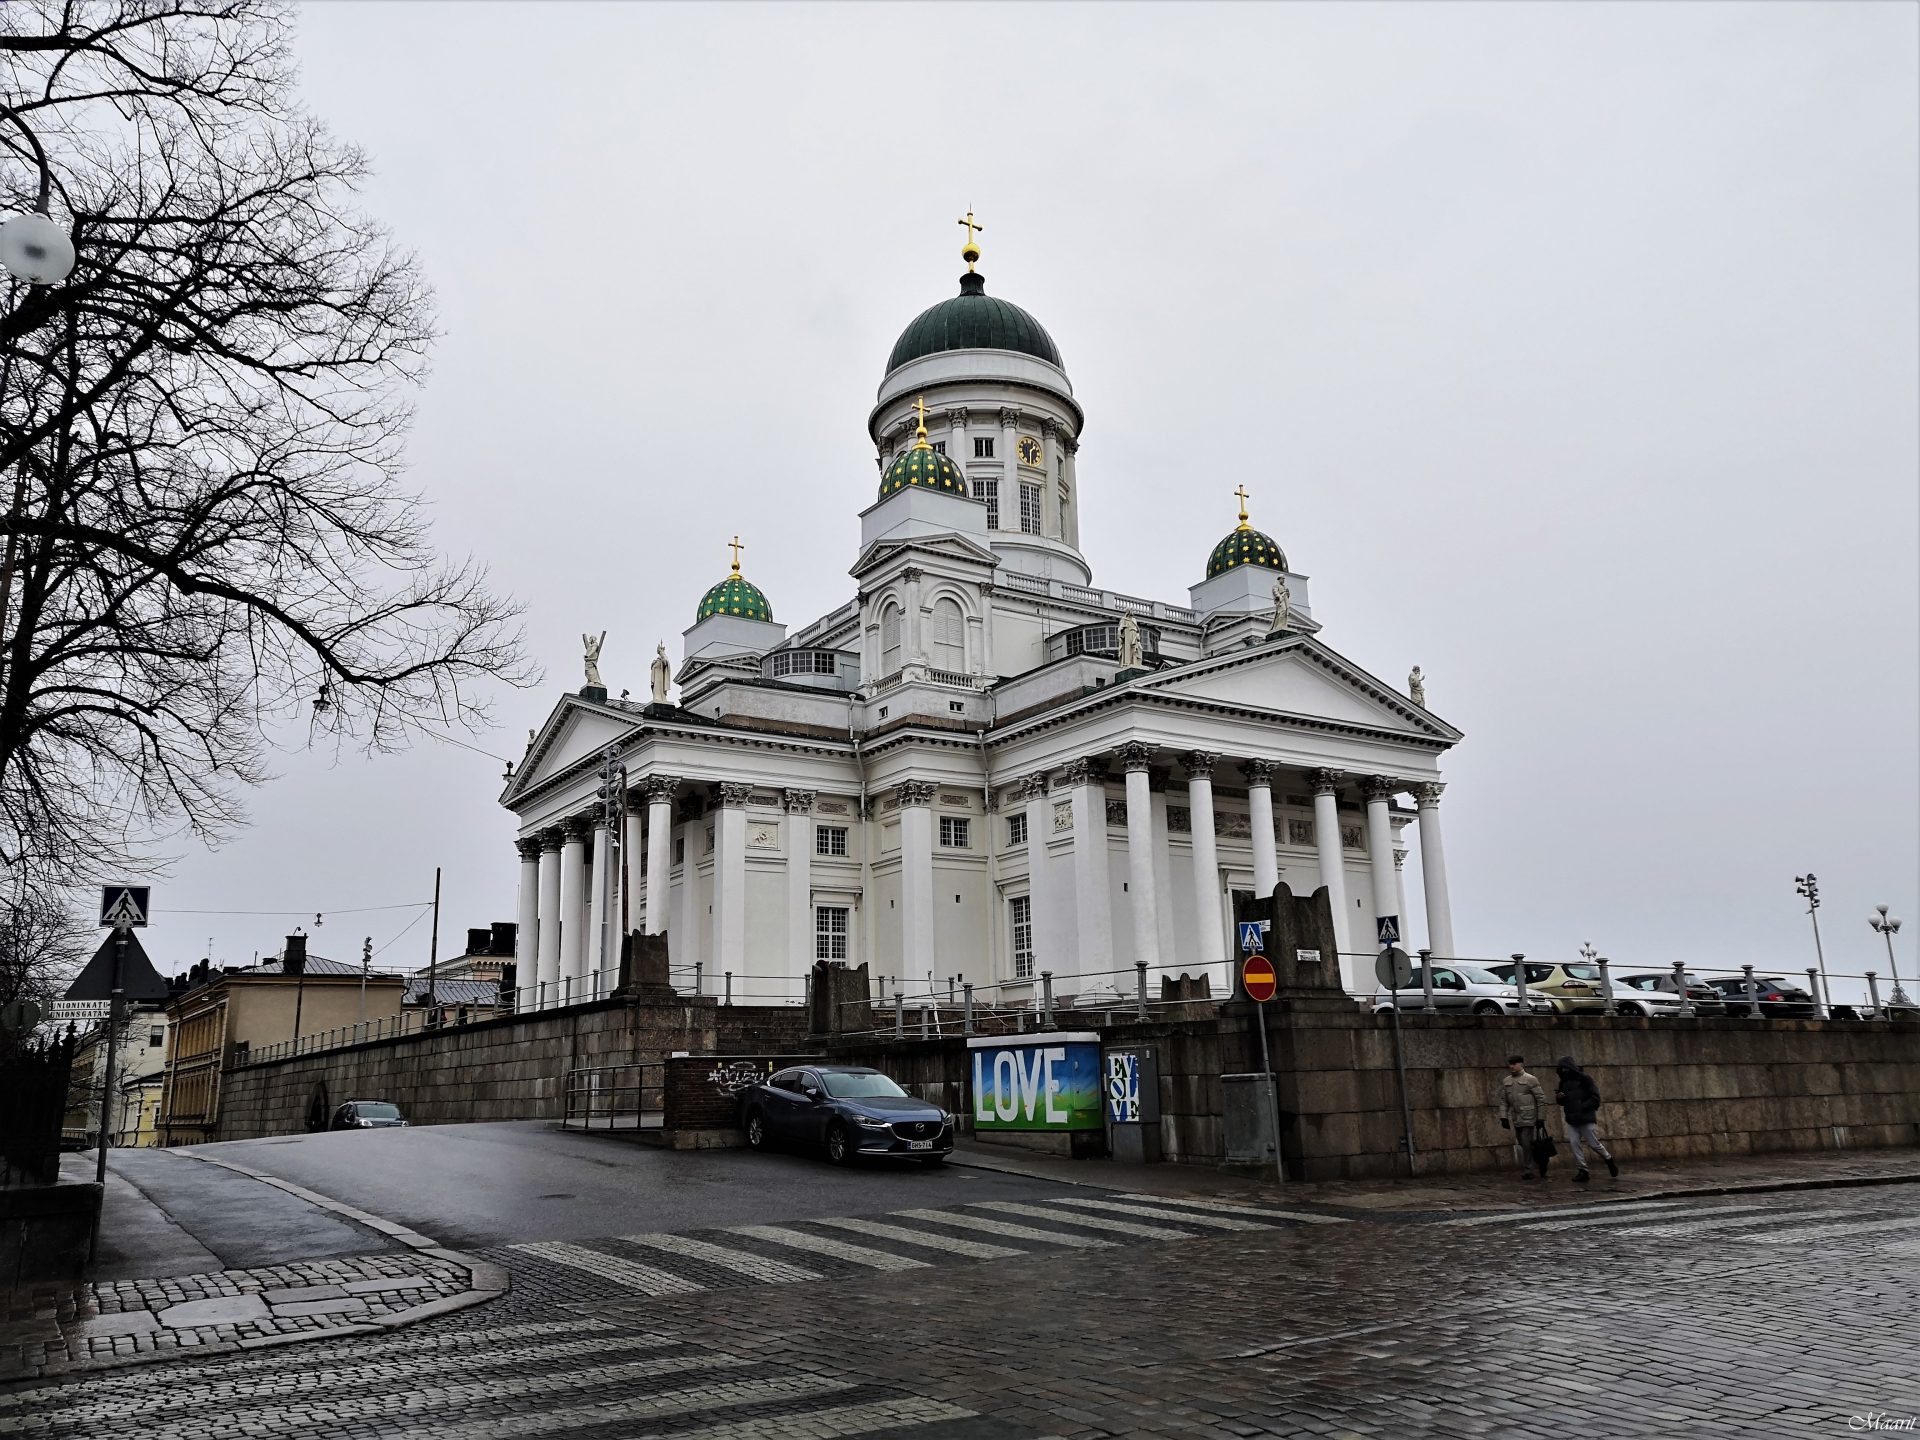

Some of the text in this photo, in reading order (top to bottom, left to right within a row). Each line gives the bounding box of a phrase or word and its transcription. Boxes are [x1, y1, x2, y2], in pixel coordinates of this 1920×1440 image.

[52, 1001, 110, 1009] UNIONINKATU
[51, 1011, 109, 1019] UNIONSGATAN
[974, 1047, 1068, 1123] LOVE
